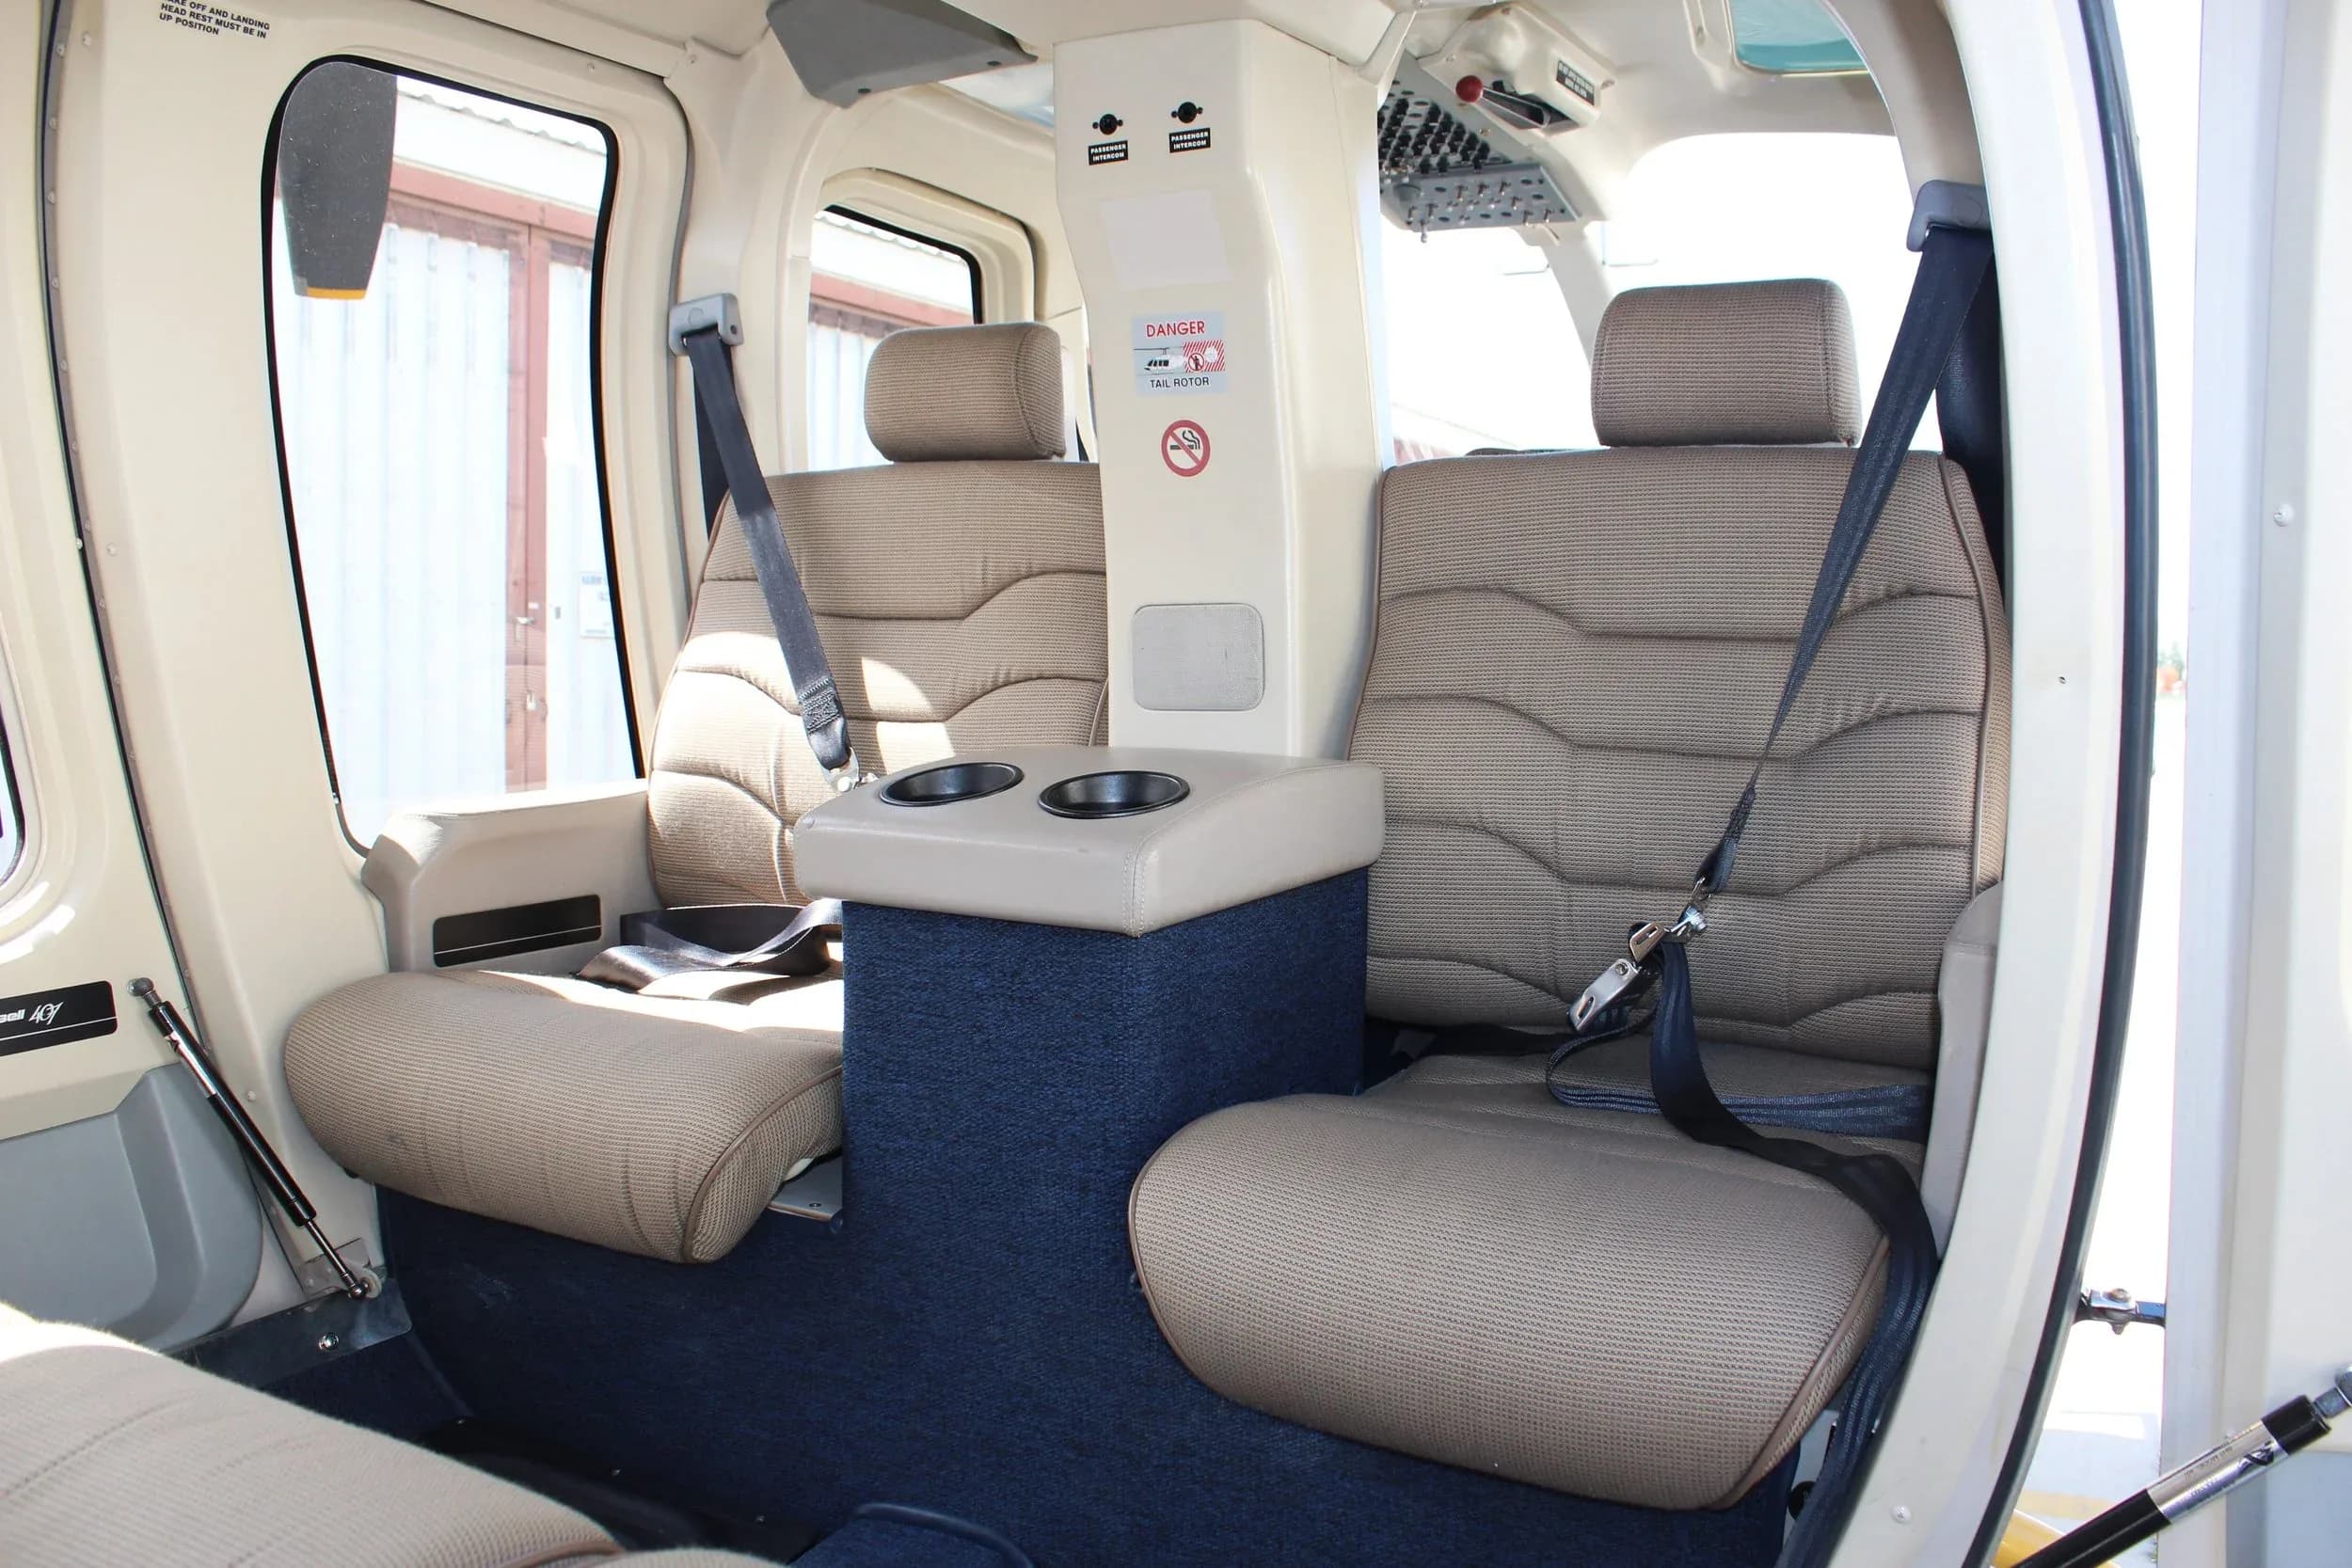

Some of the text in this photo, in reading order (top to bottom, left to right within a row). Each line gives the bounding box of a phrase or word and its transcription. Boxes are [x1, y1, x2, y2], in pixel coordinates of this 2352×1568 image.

[161, 3, 267, 39] HEAD REST MUST BE IN
[189, 2, 207, 11] OFF
[209, 8, 229, 18] AND
[230, 13, 270, 30] LANDING
[159, 12, 219, 35] UP POSITION
[1171, 132, 1209, 142] PASSENGER
[1090, 143, 1127, 154] PASSENGER
[1173, 140, 1207, 150] INTERCOM
[1092, 151, 1125, 162] INTERCOM
[1146, 321, 1205, 338] DANGER
[1150, 376, 1210, 388] TAIL ROTOR
[28, 1001, 64, 1025] 407
